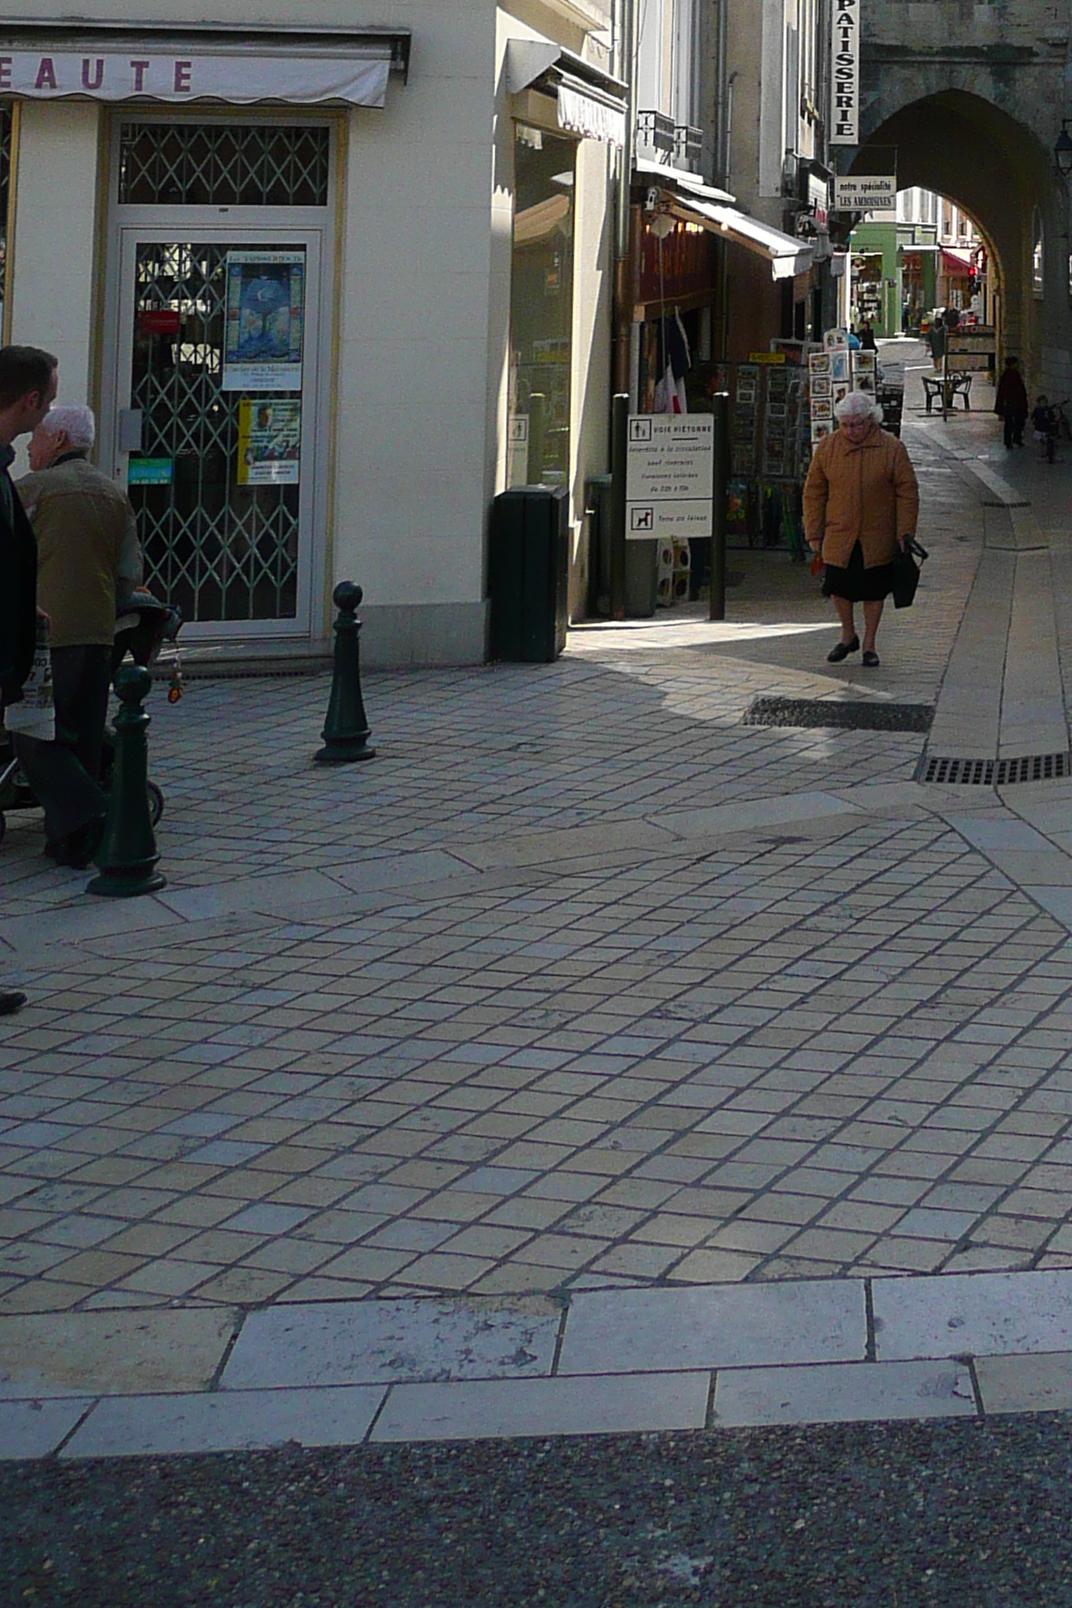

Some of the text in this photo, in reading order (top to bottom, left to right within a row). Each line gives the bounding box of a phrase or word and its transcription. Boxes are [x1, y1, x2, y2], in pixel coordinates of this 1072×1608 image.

[839, 180, 891, 194] notre spécialité
[653, 424, 712, 433] VOIE PIÉTONNE
